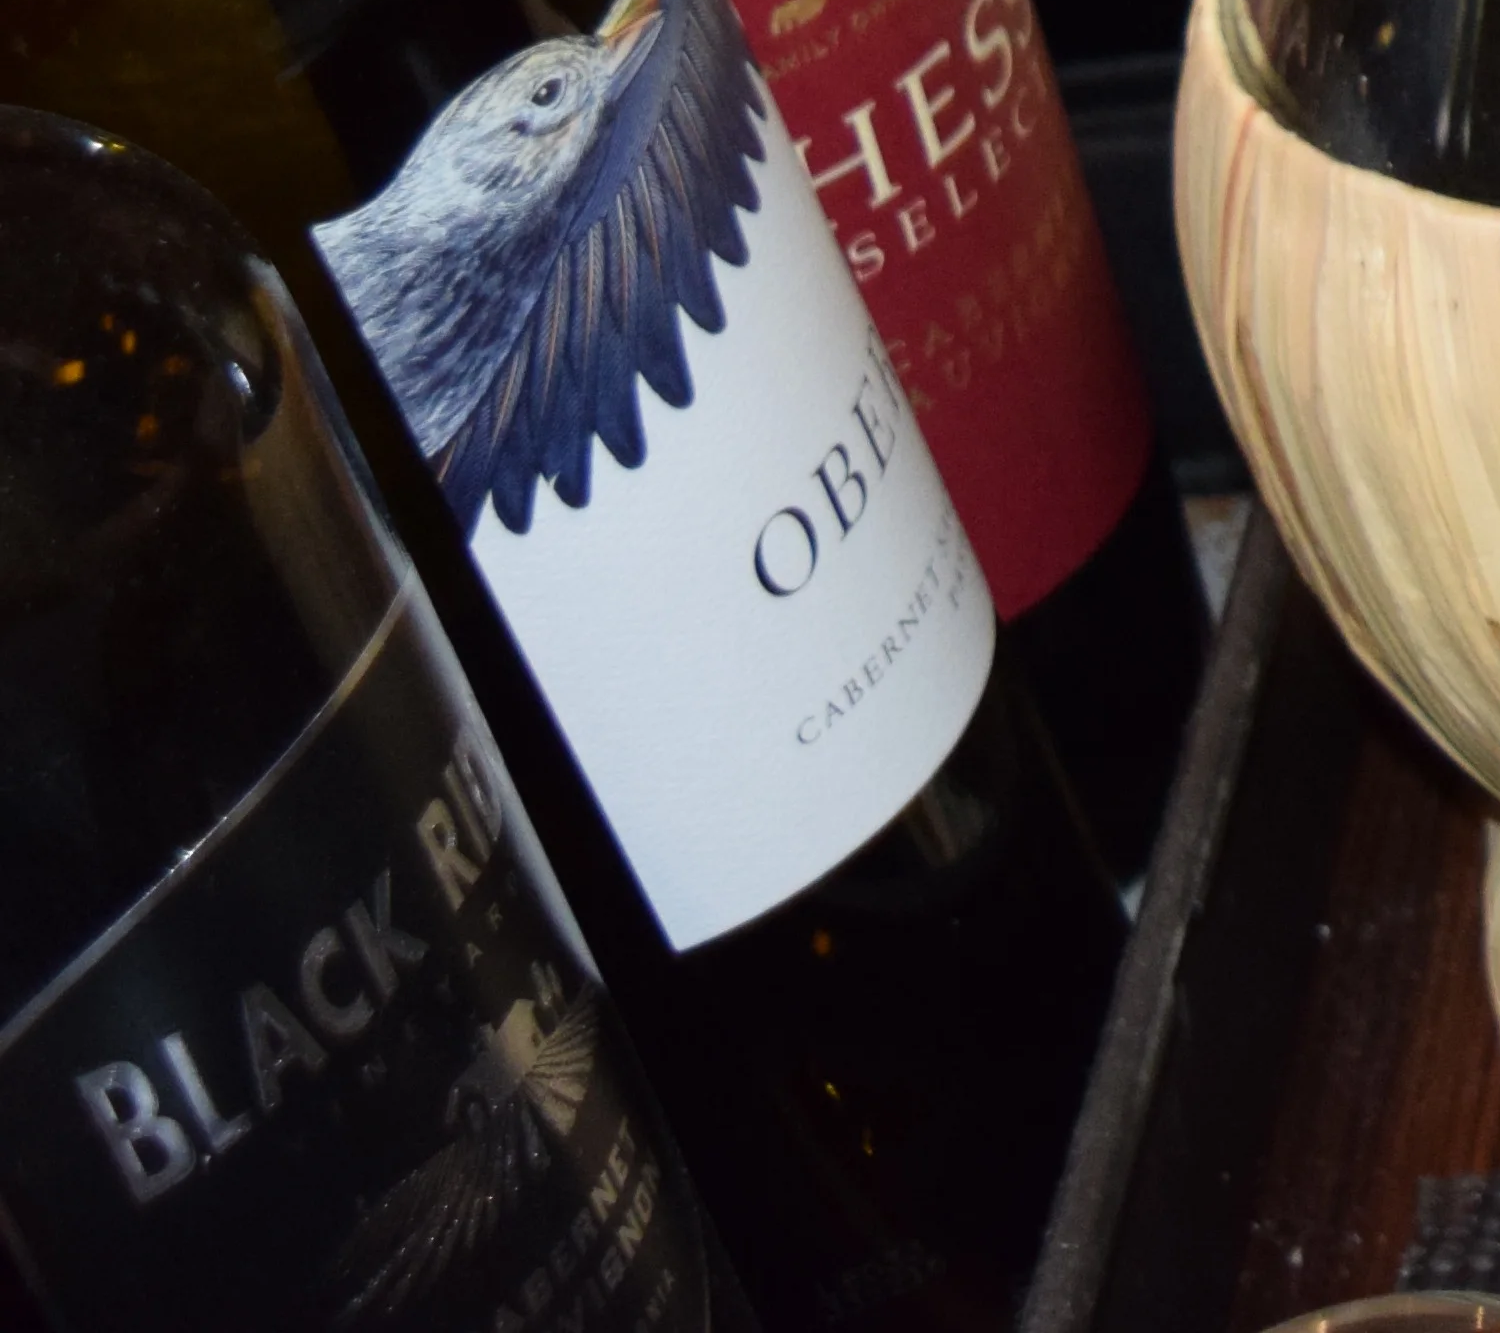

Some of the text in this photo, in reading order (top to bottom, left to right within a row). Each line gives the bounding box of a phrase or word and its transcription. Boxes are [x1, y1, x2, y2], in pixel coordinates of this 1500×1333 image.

[763, 23, 844, 85] AMILY
[846, 66, 1045, 285] SELEC
[796, 555, 942, 748] CABERNET
[73, 865, 431, 1204] BLACK
